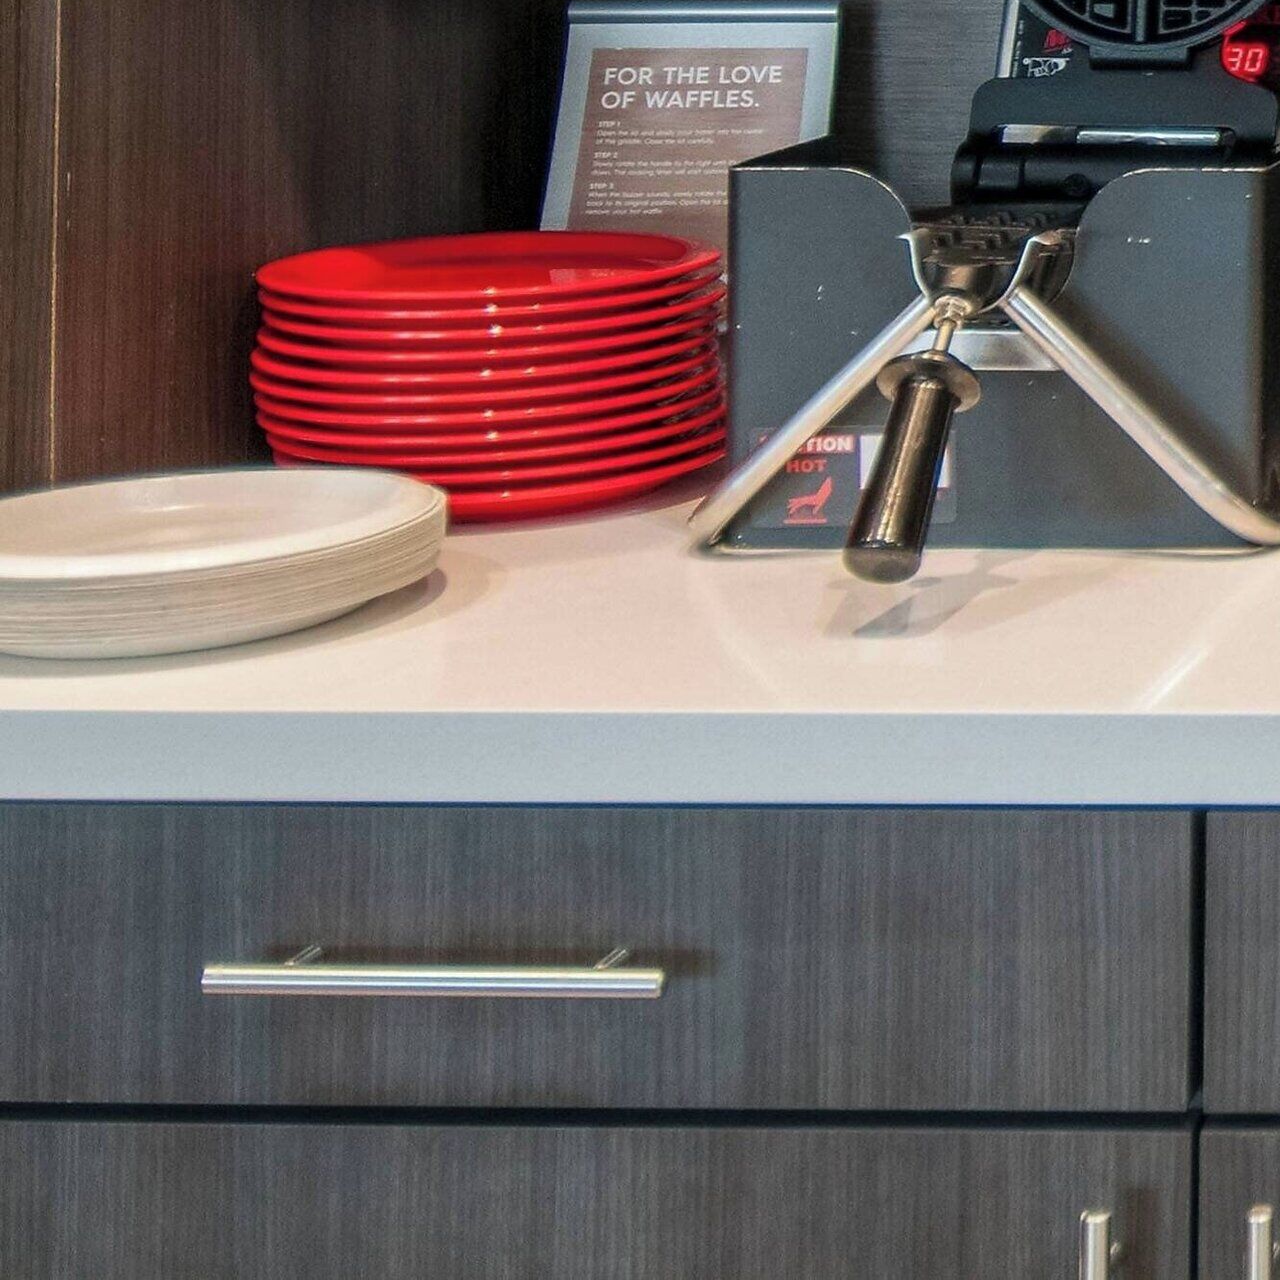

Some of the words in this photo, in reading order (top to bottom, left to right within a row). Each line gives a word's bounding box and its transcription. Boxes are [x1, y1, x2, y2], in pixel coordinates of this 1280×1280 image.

[1228, 47, 1263, 72] 30
[604, 67, 652, 85] FOR
[663, 66, 709, 85] THE
[719, 65, 783, 84] LOVE
[601, 91, 636, 109] OF
[645, 90, 760, 108] WAFFLES.
[787, 460, 827, 473] HOT
